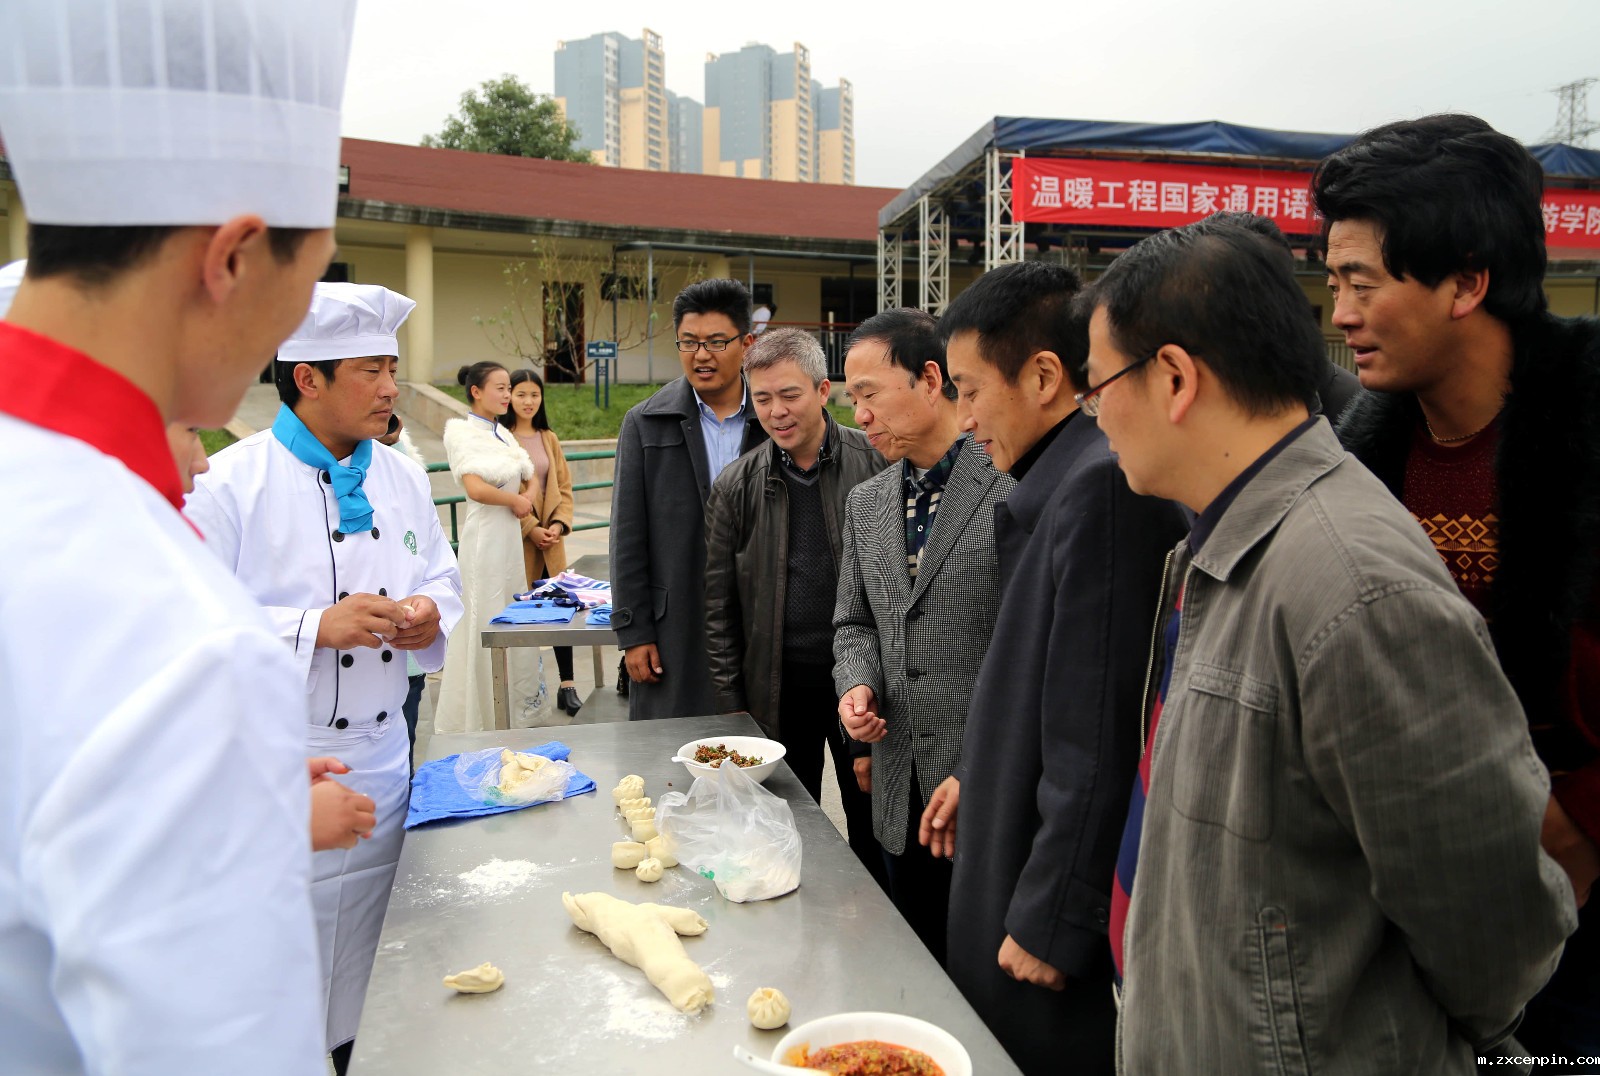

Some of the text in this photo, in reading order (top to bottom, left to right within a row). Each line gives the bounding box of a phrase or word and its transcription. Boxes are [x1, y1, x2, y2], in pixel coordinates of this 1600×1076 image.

[1030, 175, 1324, 220] 温暖工程国家通用语
